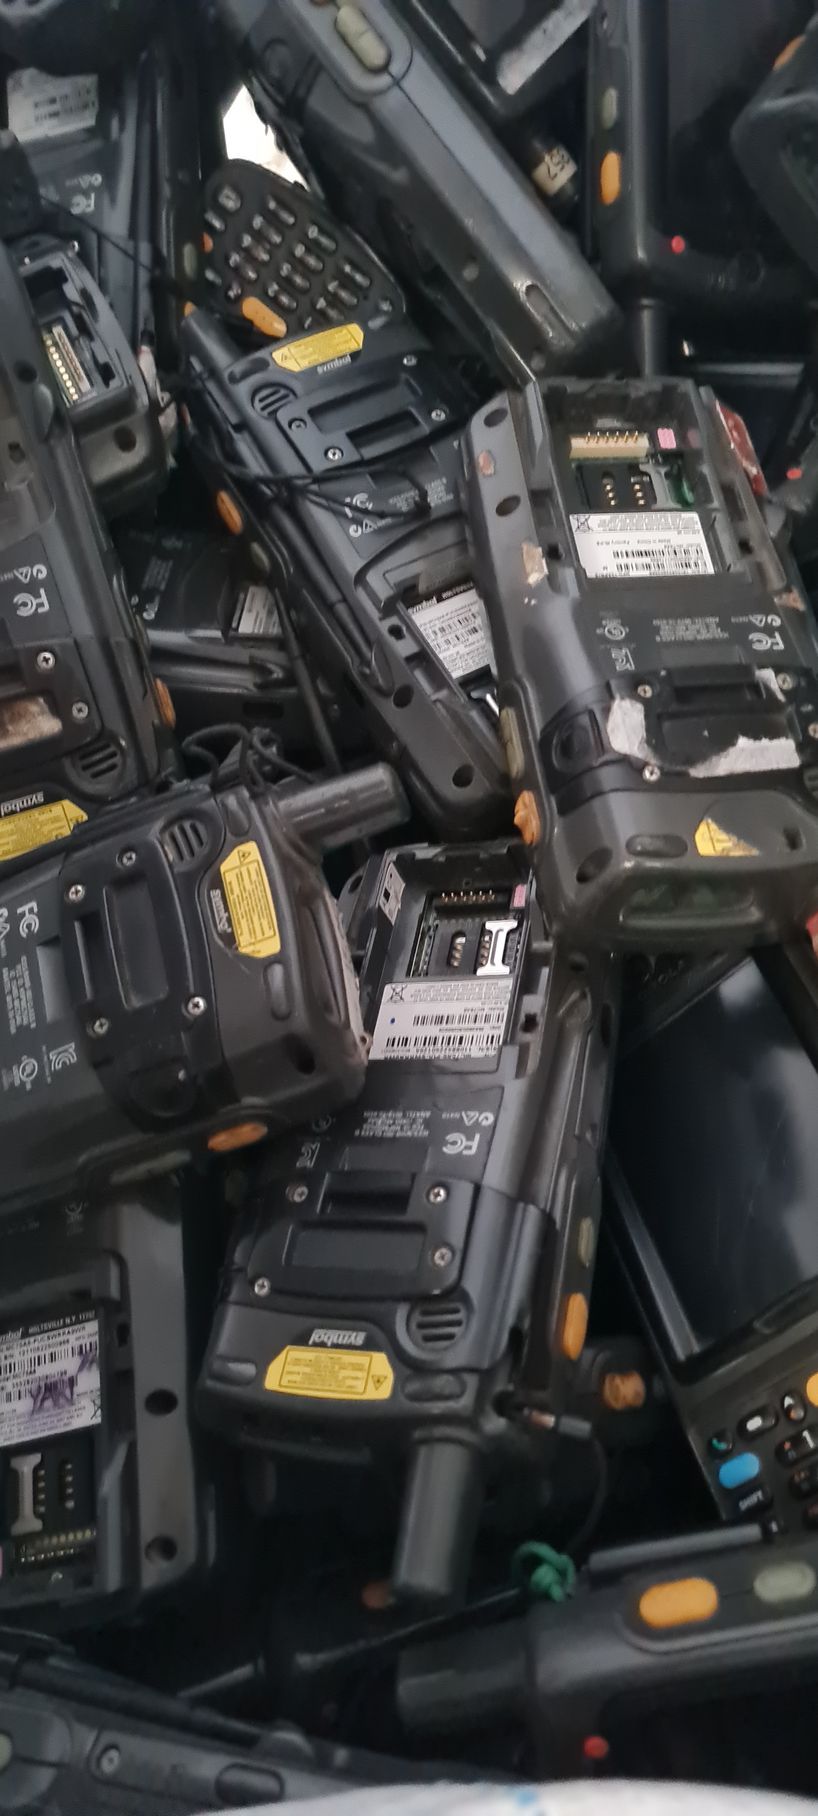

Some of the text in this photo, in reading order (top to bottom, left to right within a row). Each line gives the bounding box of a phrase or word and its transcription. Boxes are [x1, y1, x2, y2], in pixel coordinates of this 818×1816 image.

[0, 791, 44, 816] symbol
[210, 888, 232, 934] symbol
[309, 1328, 367, 1346] symbol
